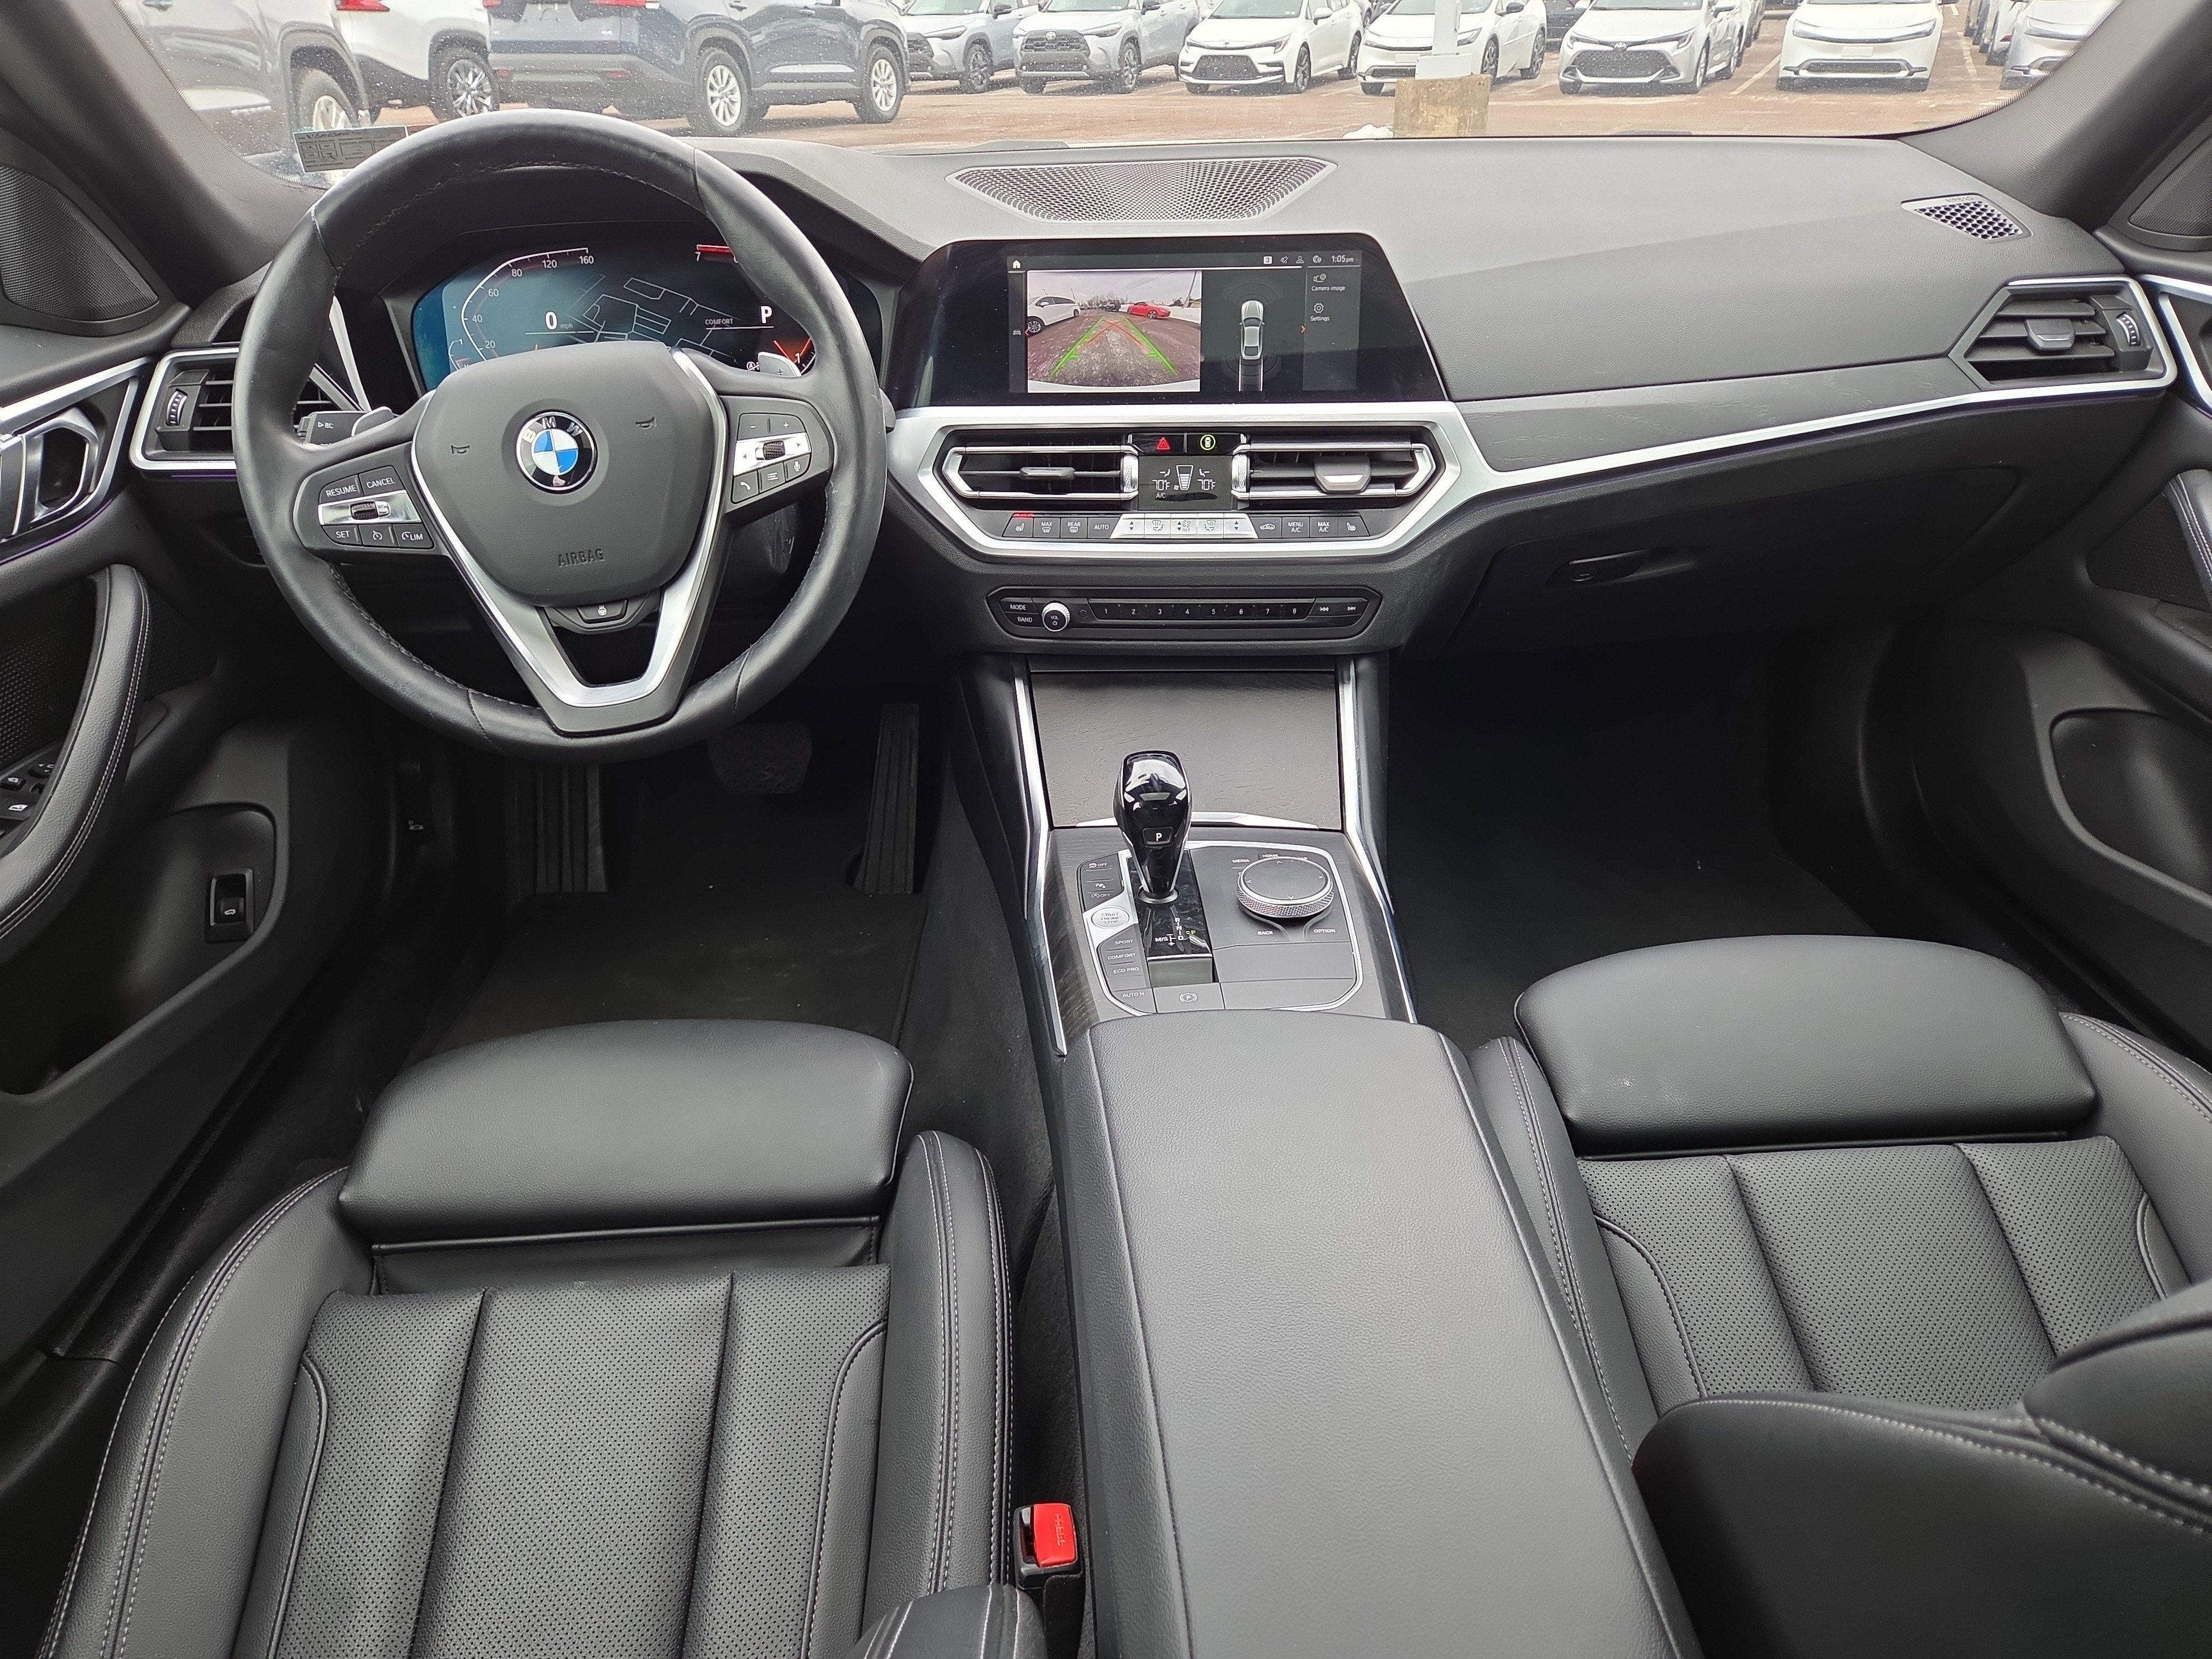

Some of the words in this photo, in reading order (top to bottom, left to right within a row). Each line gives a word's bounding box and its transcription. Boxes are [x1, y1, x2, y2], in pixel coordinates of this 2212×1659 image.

[579, 255, 594, 265] 160
[695, 252, 701, 261] 7
[543, 260, 557, 268] 120
[511, 269, 523, 277] 80
[488, 288, 499, 297] 60
[472, 314, 483, 323] 40
[761, 306, 773, 324] P
[545, 311, 558, 330] 0
[485, 340, 496, 349] 20
[795, 352, 800, 364] 1
[522, 416, 583, 443] BMW
[366, 477, 396, 488] CANCEL
[326, 484, 357, 497] RESUME
[336, 530, 350, 538] SET
[410, 533, 423, 541] LIM
[558, 548, 606, 568] AIRBAG
[1155, 832, 1162, 841] P
